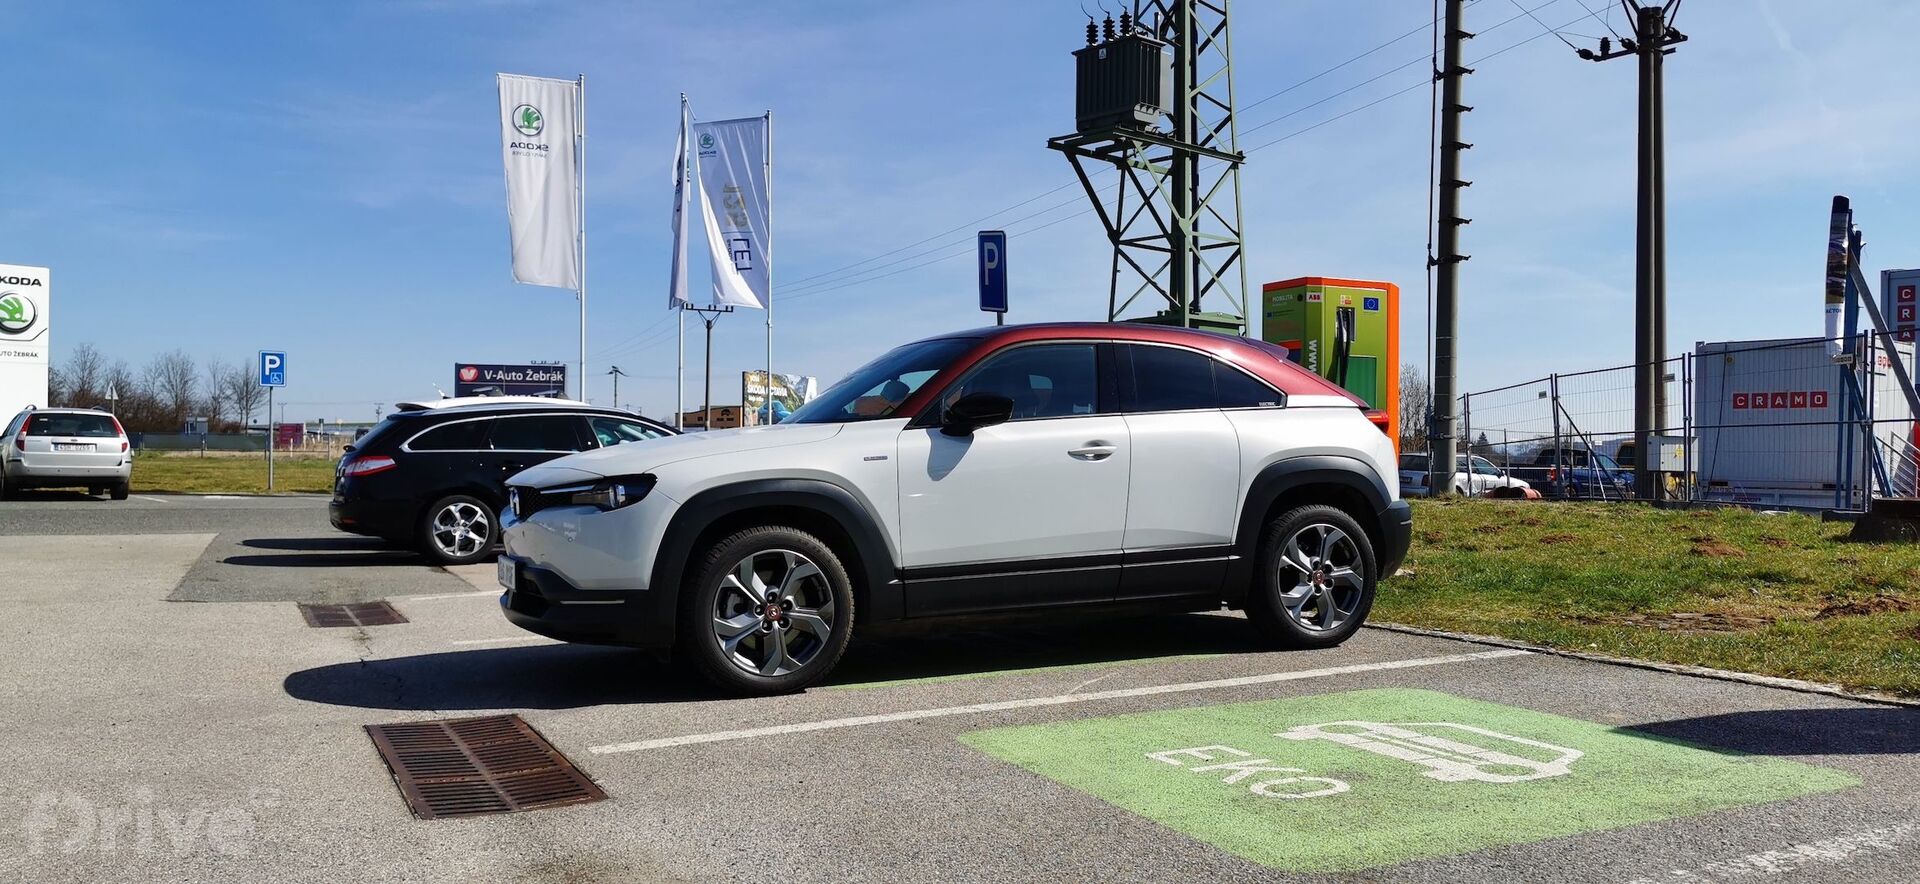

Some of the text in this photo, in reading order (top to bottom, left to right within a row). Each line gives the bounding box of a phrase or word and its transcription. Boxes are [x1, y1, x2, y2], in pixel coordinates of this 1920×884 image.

[984, 242, 998, 285] P
[265, 355, 281, 376] P
[484, 368, 564, 382] V-Auto Žebrák
[1735, 393, 1825, 407] CRAMO
[1145, 744, 1351, 799] EKO
